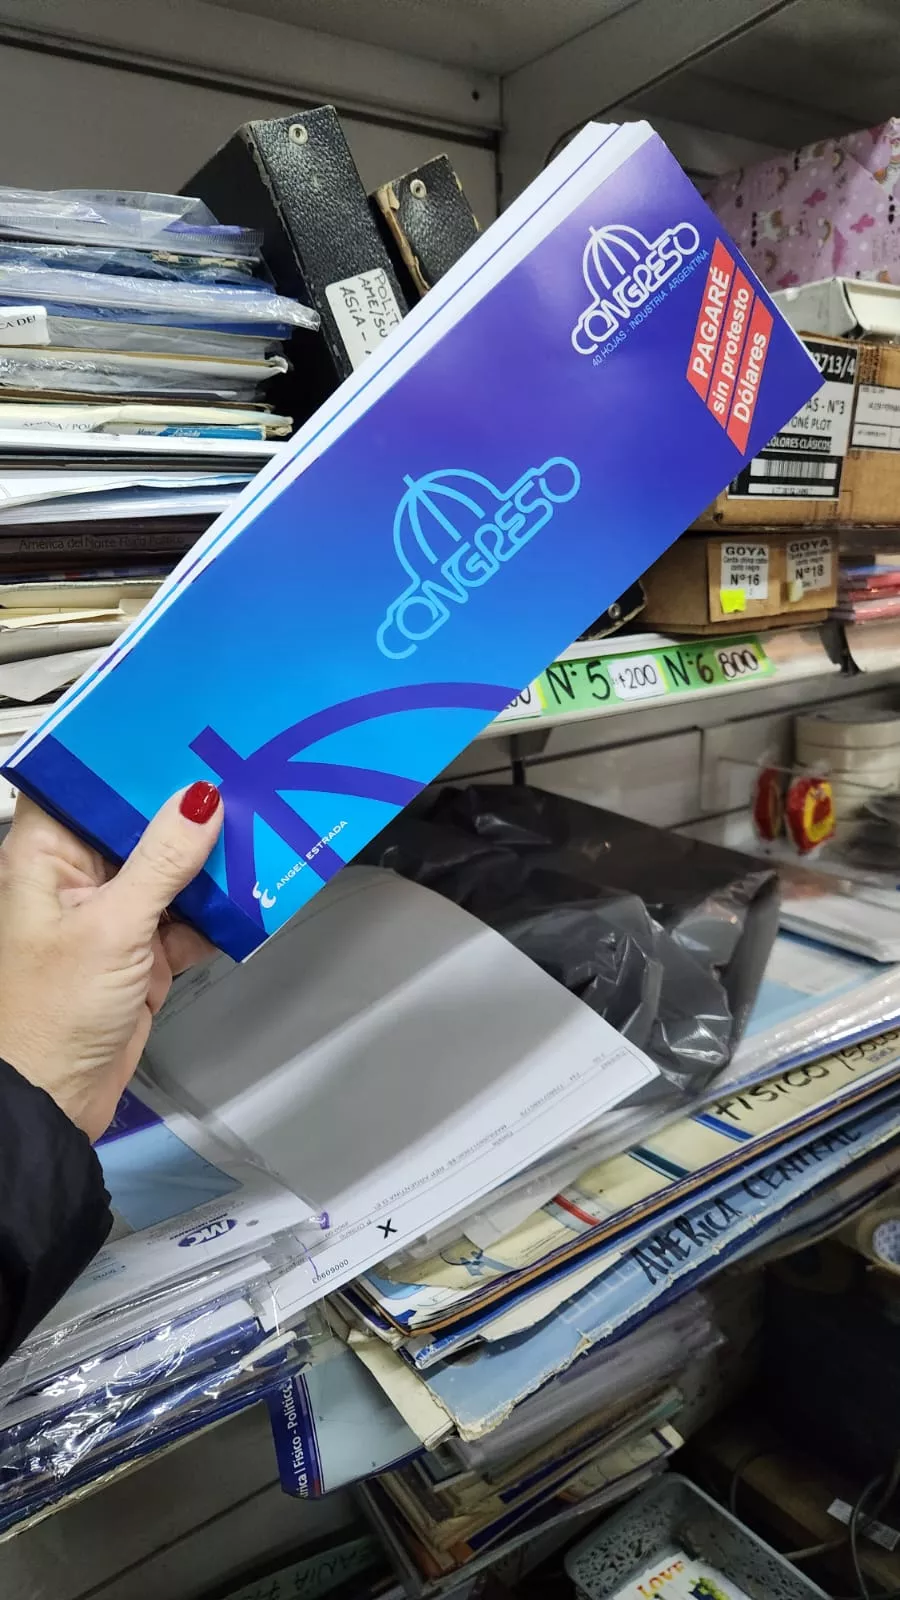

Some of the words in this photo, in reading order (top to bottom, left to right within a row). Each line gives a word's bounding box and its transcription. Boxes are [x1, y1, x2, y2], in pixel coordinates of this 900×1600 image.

[571, 222, 700, 354] CONGRESO
[592, 354, 603, 367] 40
[600, 330, 628, 358] HOJAS
[628, 289, 668, 331] INDUSTRIA
[668, 249, 710, 292] ARGENTINA
[692, 266, 730, 379] PAGARÉ
[721, 288, 750, 380] protesto
[733, 332, 767, 424] Dólares
[713, 382, 730, 415] sin
[376, 456, 581, 660] CONGRESO
[725, 546, 766, 557] GOYA
[789, 538, 830, 553] GOYA
[718, 650, 759, 678] 800
[275, 860, 308, 890] ANGEL
[305, 820, 349, 861] ESTRADA
[632, 1196, 743, 1286] AMERICA
